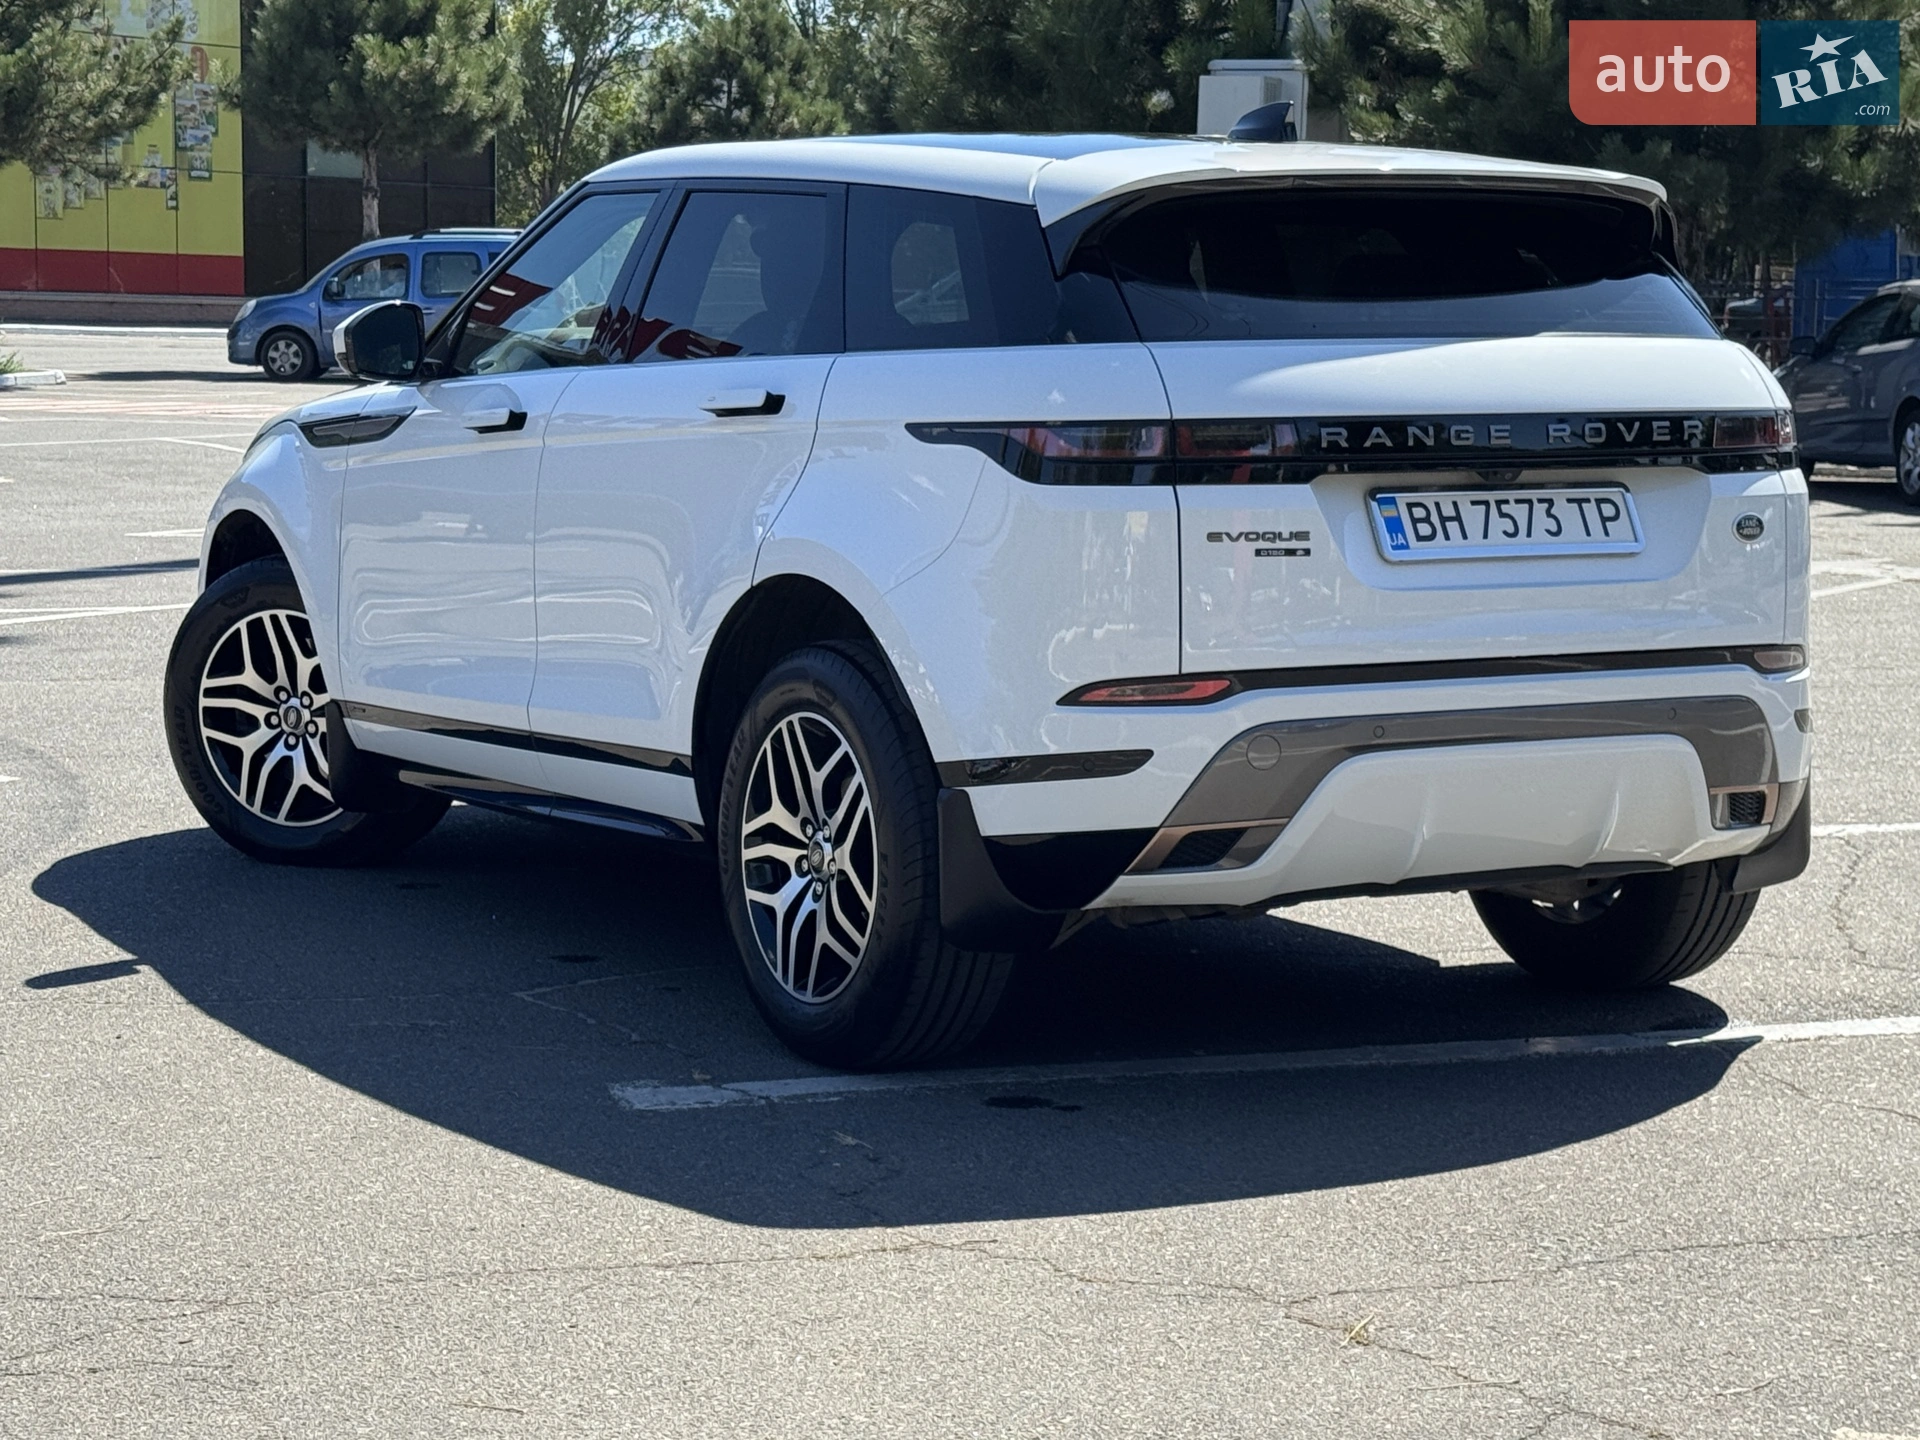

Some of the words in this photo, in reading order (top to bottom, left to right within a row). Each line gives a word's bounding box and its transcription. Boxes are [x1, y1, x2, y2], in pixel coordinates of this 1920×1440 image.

[1320, 424, 1511, 448] RANGE
[1547, 420, 1704, 445] ROVER
[1405, 501, 1469, 542] BH
[1470, 497, 1563, 540] 7573
[1566, 497, 1621, 538] TP
[1206, 531, 1311, 544] EVOQUE
[1390, 532, 1407, 546] UA
